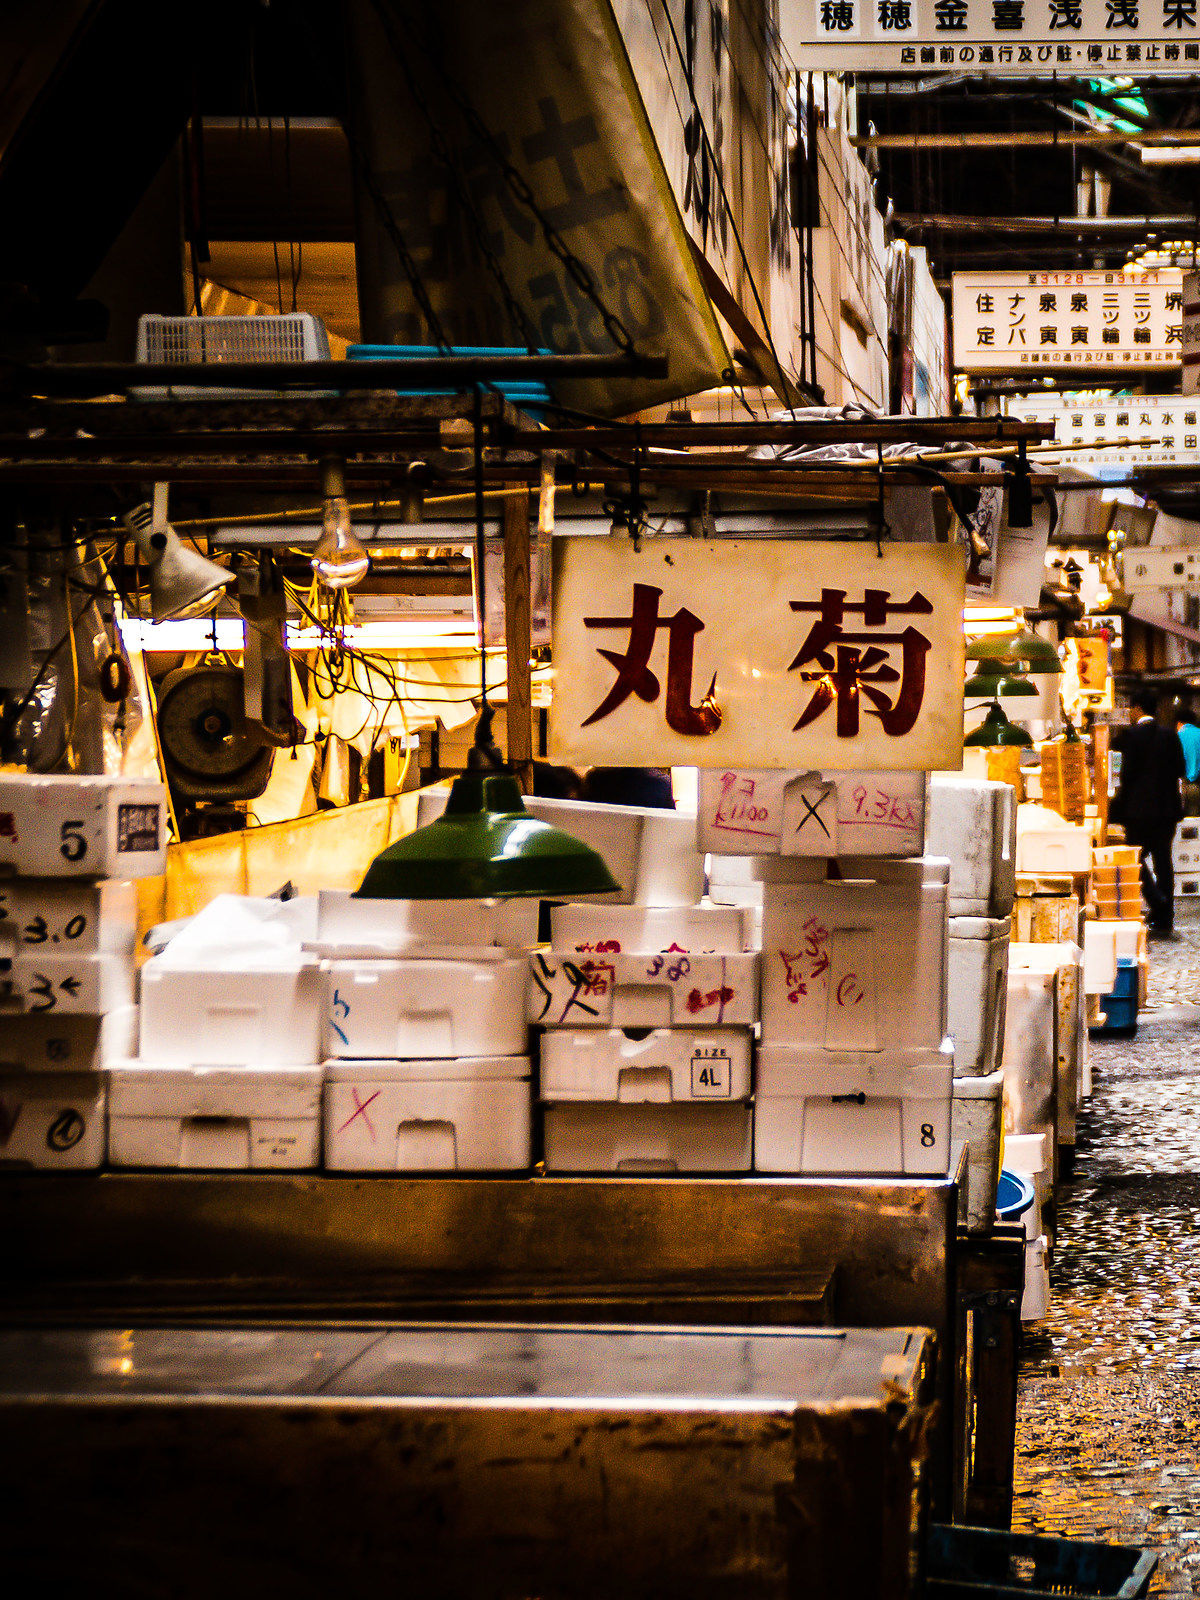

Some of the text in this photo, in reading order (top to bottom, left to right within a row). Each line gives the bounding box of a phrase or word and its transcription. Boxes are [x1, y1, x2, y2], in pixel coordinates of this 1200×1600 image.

[60, 820, 87, 861] 5
[694, 1048, 726, 1057] SIZE
[699, 1067, 721, 1086] 4L
[920, 1123, 936, 1148] 8
